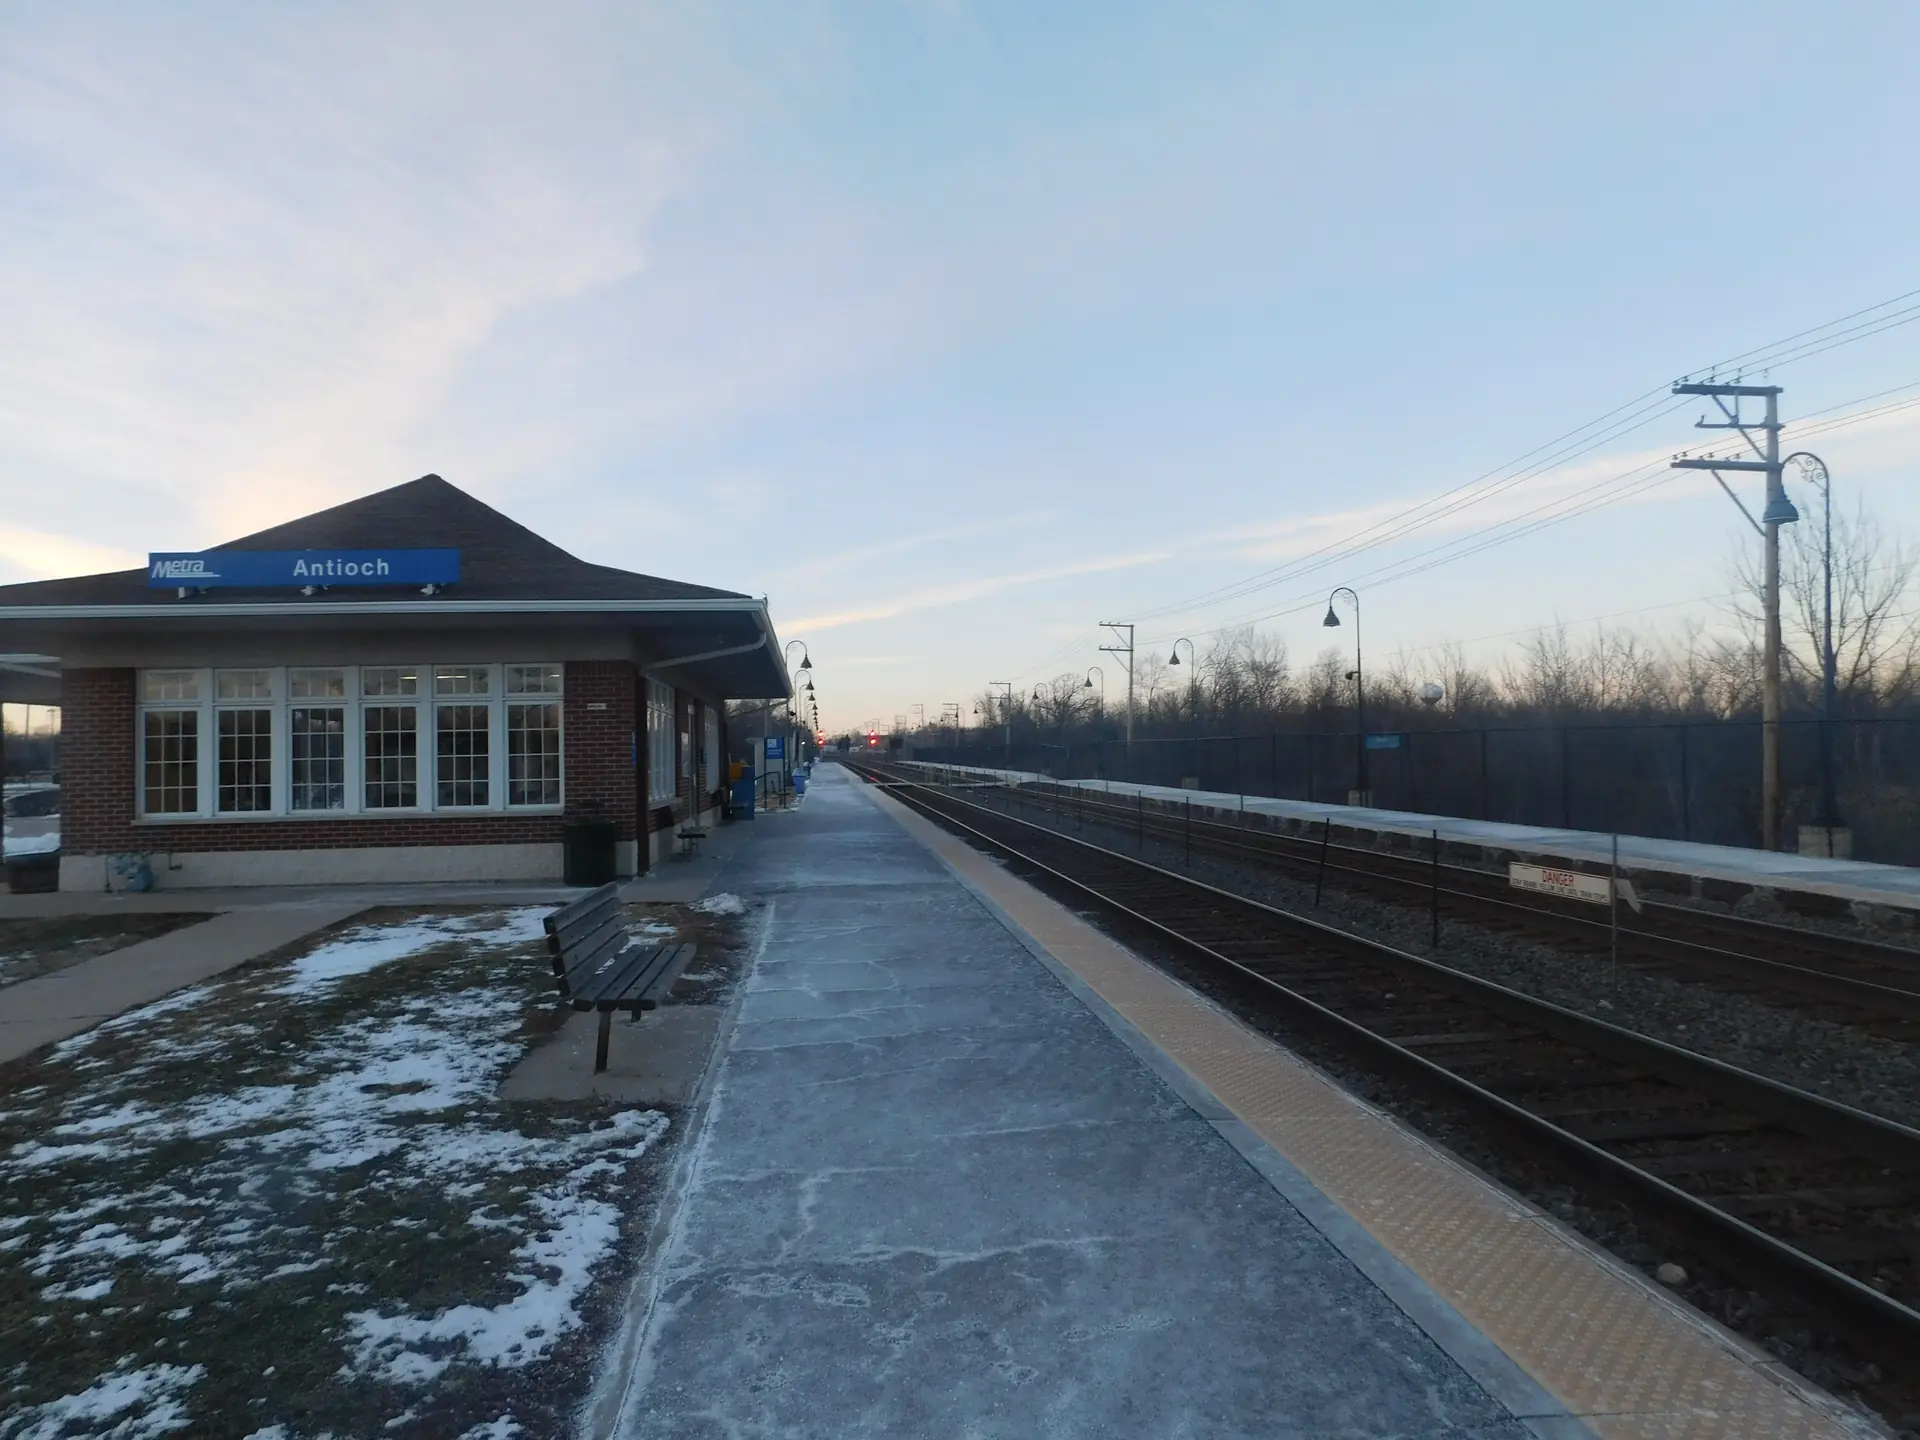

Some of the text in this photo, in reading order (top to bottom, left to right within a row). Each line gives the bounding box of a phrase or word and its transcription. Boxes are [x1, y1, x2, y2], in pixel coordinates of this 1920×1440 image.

[152, 559, 205, 578] Metra
[293, 558, 389, 576] Antioch
[1541, 870, 1574, 887] DANGER
